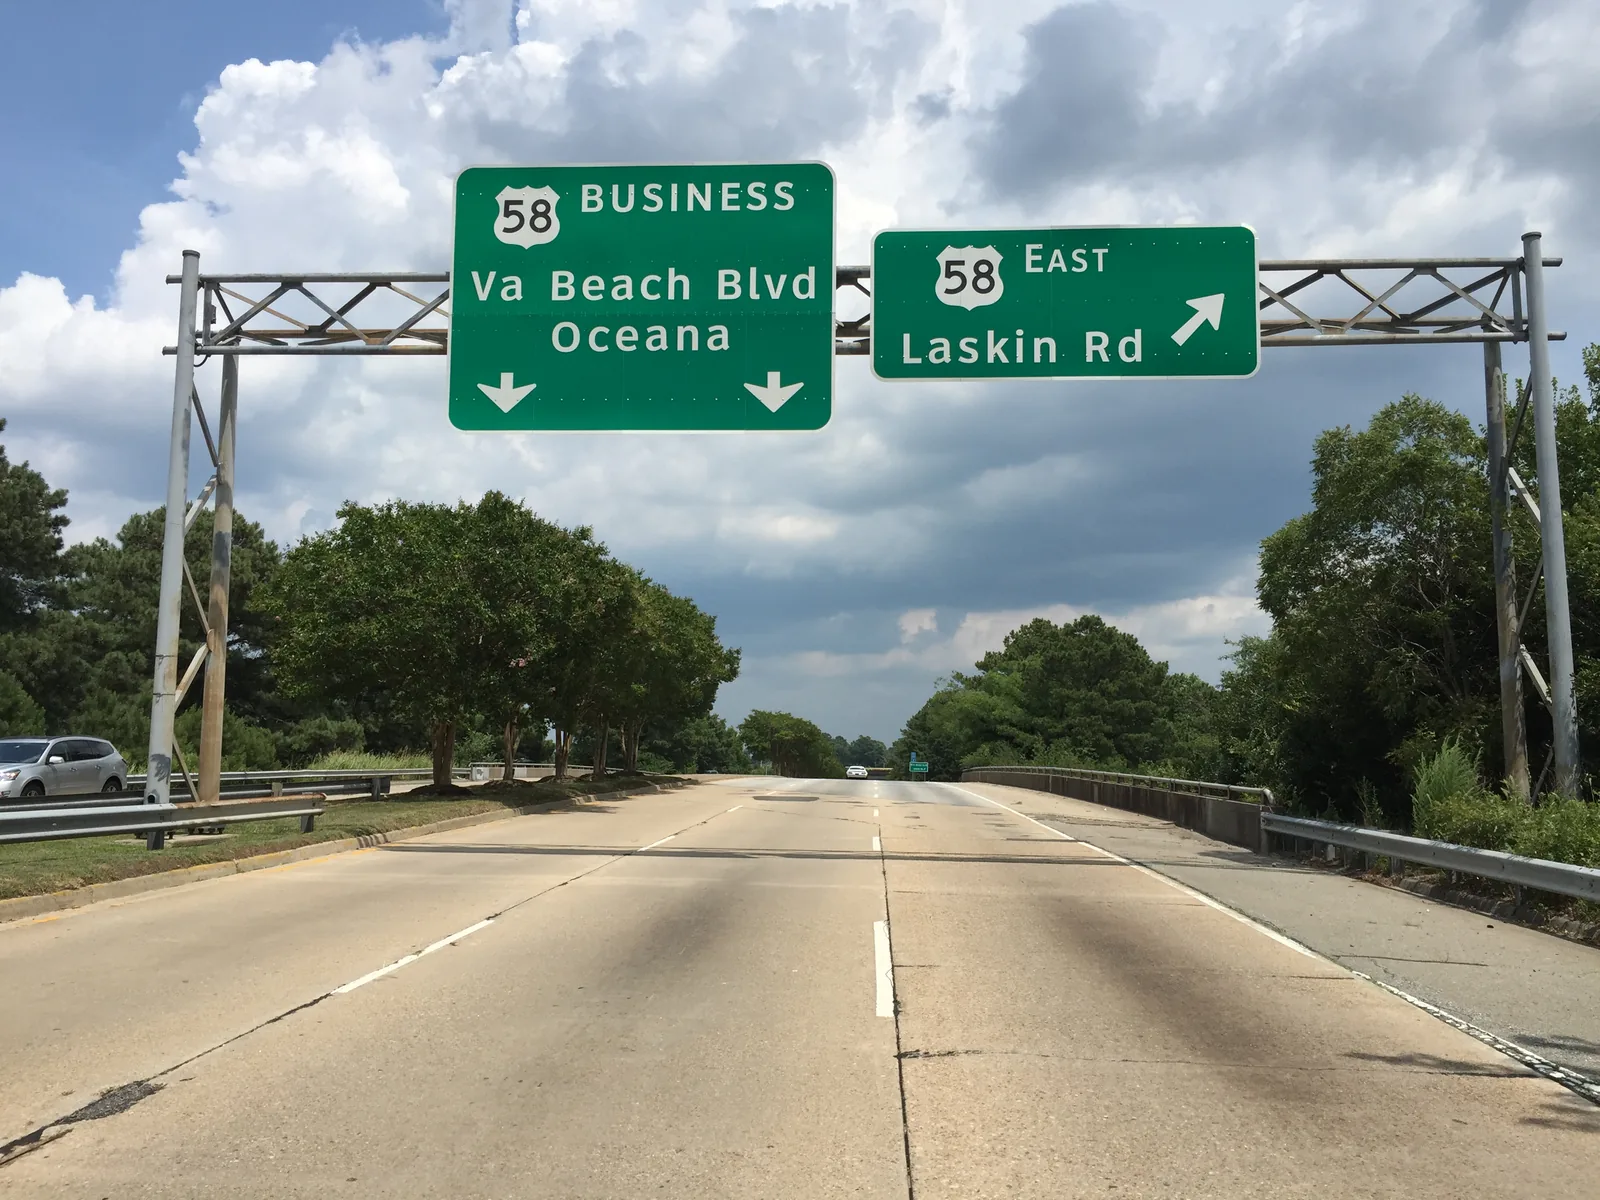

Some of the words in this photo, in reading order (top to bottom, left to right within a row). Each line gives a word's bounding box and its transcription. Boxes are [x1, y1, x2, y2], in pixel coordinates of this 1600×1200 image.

[581, 181, 795, 213] BUSINESS
[502, 199, 552, 234] 58
[1025, 243, 1109, 273] EAST
[471, 271, 523, 302] Va
[551, 267, 690, 302] Beach
[717, 266, 816, 300] Blvd
[943, 259, 995, 294] 58
[551, 321, 730, 353] Oceana
[903, 329, 1057, 364] Laskin
[1085, 328, 1142, 363] Rd
